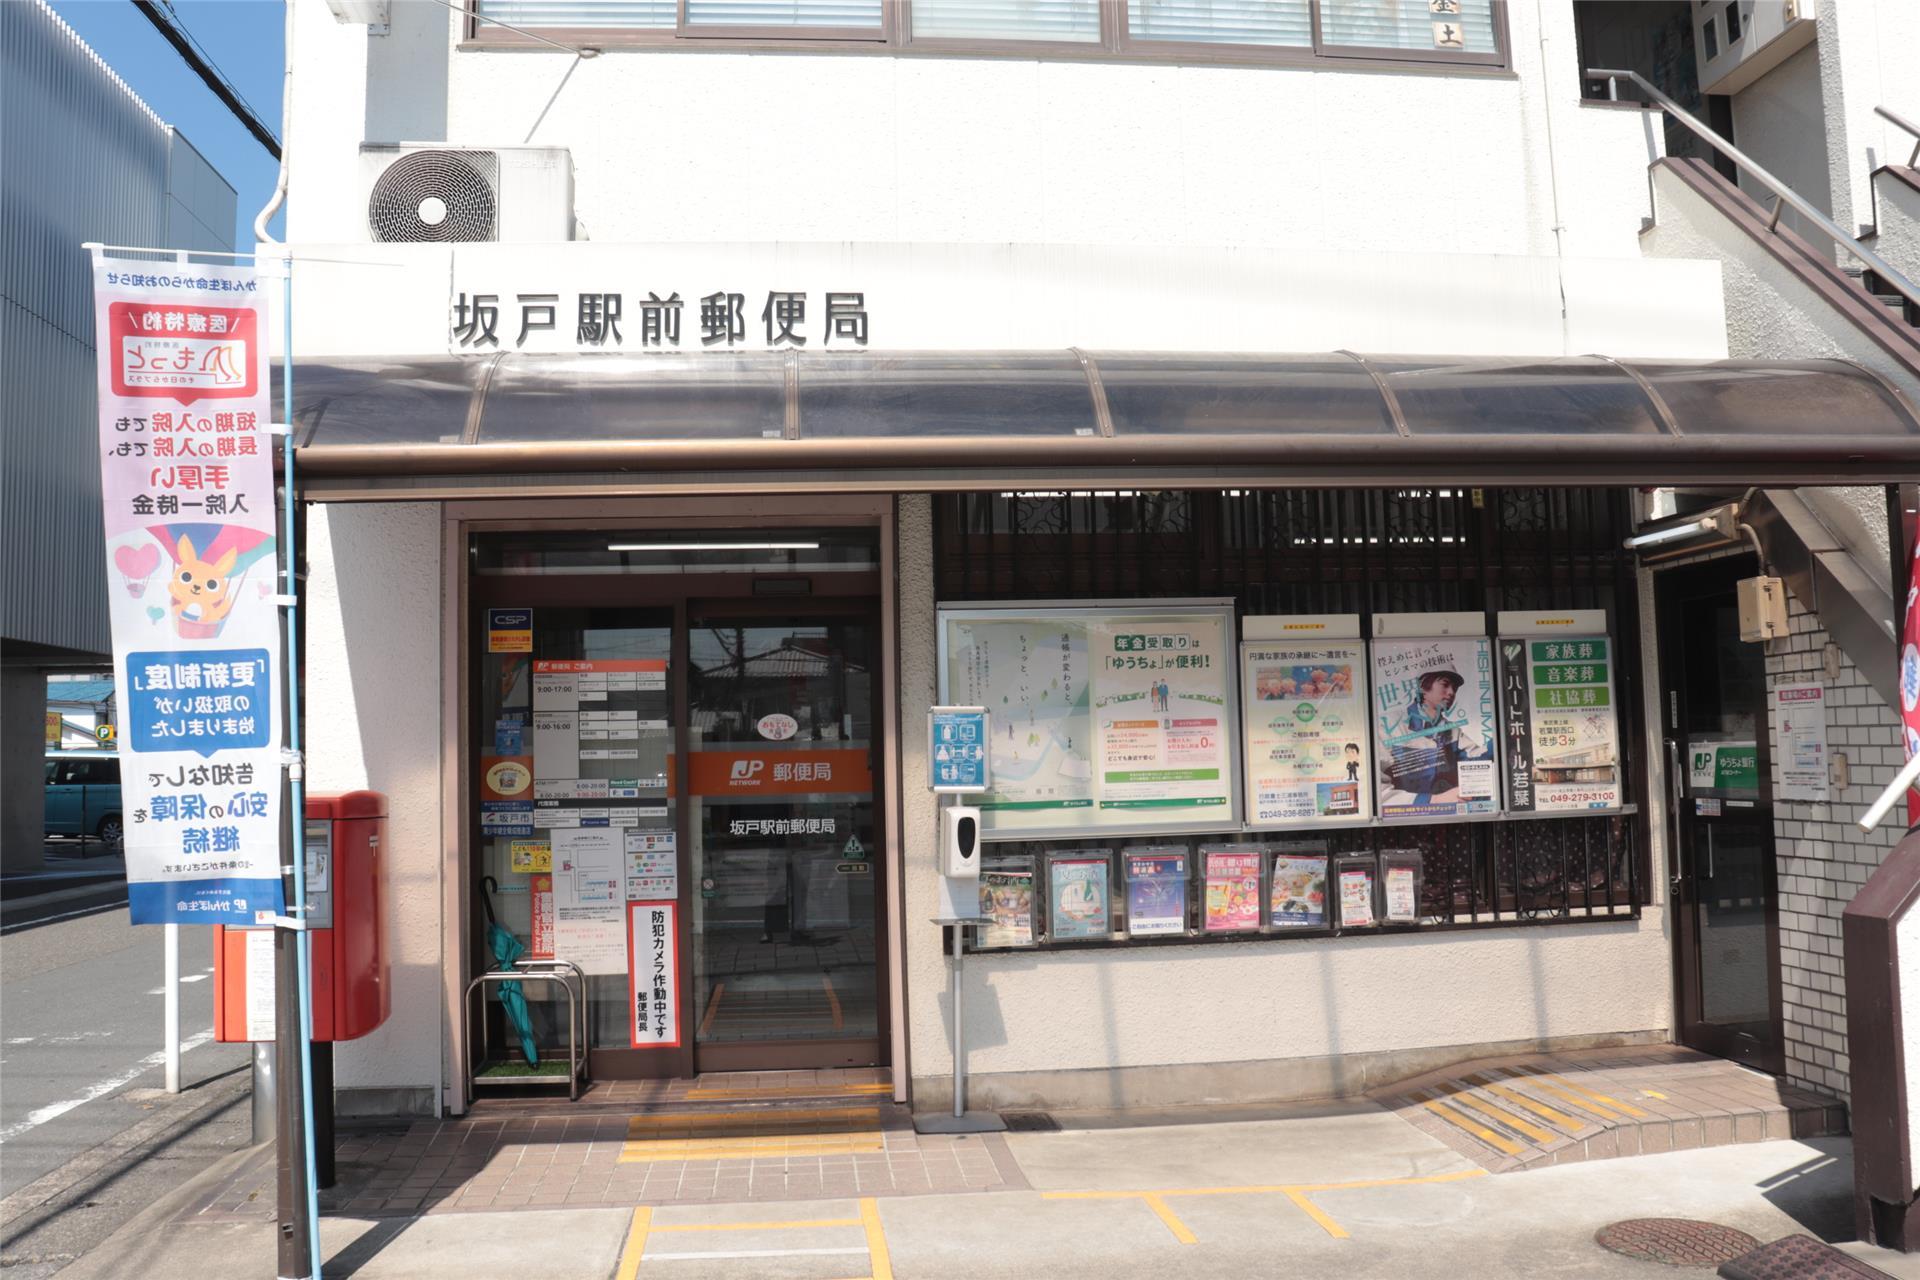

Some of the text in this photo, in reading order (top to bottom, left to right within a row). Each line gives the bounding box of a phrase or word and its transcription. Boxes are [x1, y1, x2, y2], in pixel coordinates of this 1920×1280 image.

[1439, 24, 1462, 44] 土
[453, 290, 869, 347] 坂戸駅前郵便局
[494, 615, 527, 625] CSP
[1115, 635, 1200, 651] 年金受取りは
[1545, 644, 1593, 659] 家族葬
[1377, 644, 1440, 667] 控えめに言って
[1060, 633, 1074, 706] 通帳が変わると、
[1547, 667, 1595, 682] 音楽葬
[1476, 640, 1494, 746] HISHINUMA
[1549, 690, 1597, 705] 社協葬
[101, 727, 109, 738] P
[1507, 674, 1529, 807] ハートホール若葉
[1538, 735, 1576, 748] 徒歩3分
[731, 760, 764, 780] JP
[1694, 752, 1712, 771] JP
[1719, 756, 1755, 769] ゆうちょ銀行
[773, 762, 832, 782] 郵便局
[499, 813, 531, 823] 坂戸市
[729, 819, 836, 836] 坂戸駅前郵便局
[651, 910, 668, 1039] 防犯カメラ作動中です
[637, 992, 648, 1032] 郵便局長
